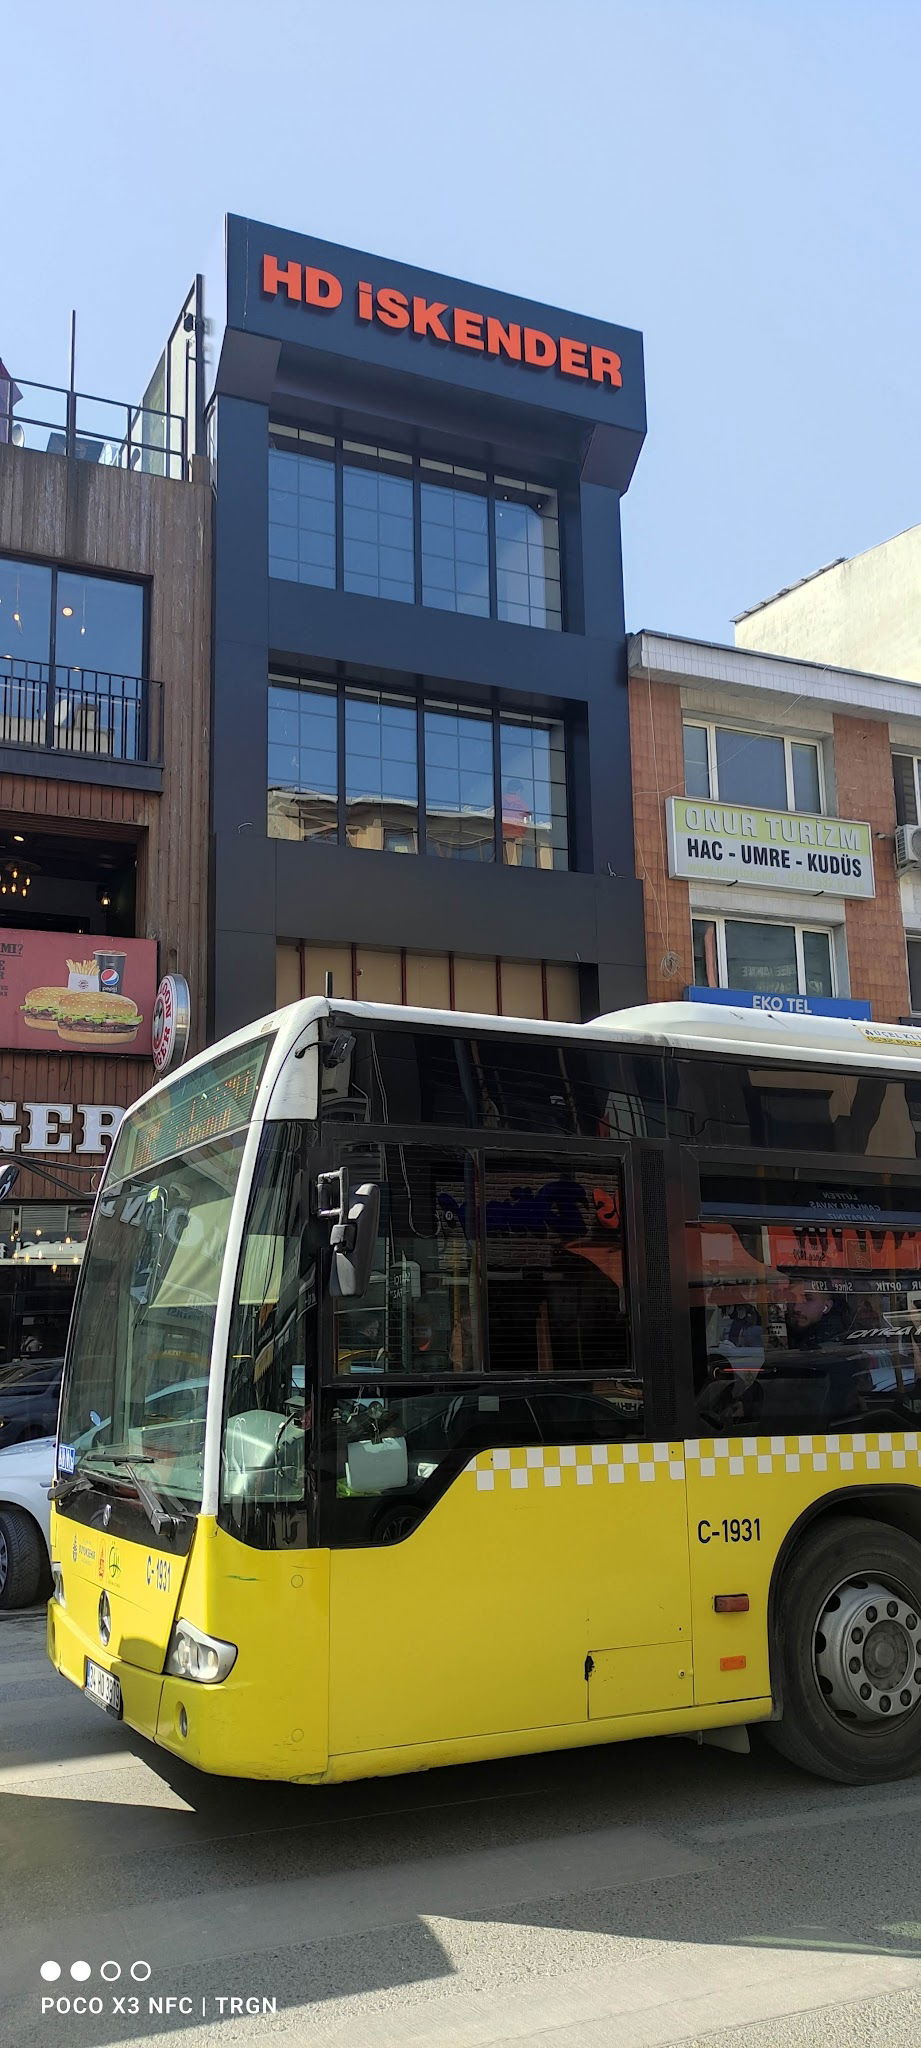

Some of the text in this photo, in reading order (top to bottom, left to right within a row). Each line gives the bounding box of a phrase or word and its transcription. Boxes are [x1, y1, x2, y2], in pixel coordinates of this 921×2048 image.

[263, 253, 343, 310] HD
[684, 807, 861, 852] ONUR TURİZM
[687, 838, 723, 861] HAC
[741, 845, 791, 869] UMRE
[808, 853, 862, 877] KUDÜS
[752, 995, 812, 1014] EKO TEL
[698, 1518, 761, 1544] C-1931
[146, 1555, 172, 1593] C-1931
